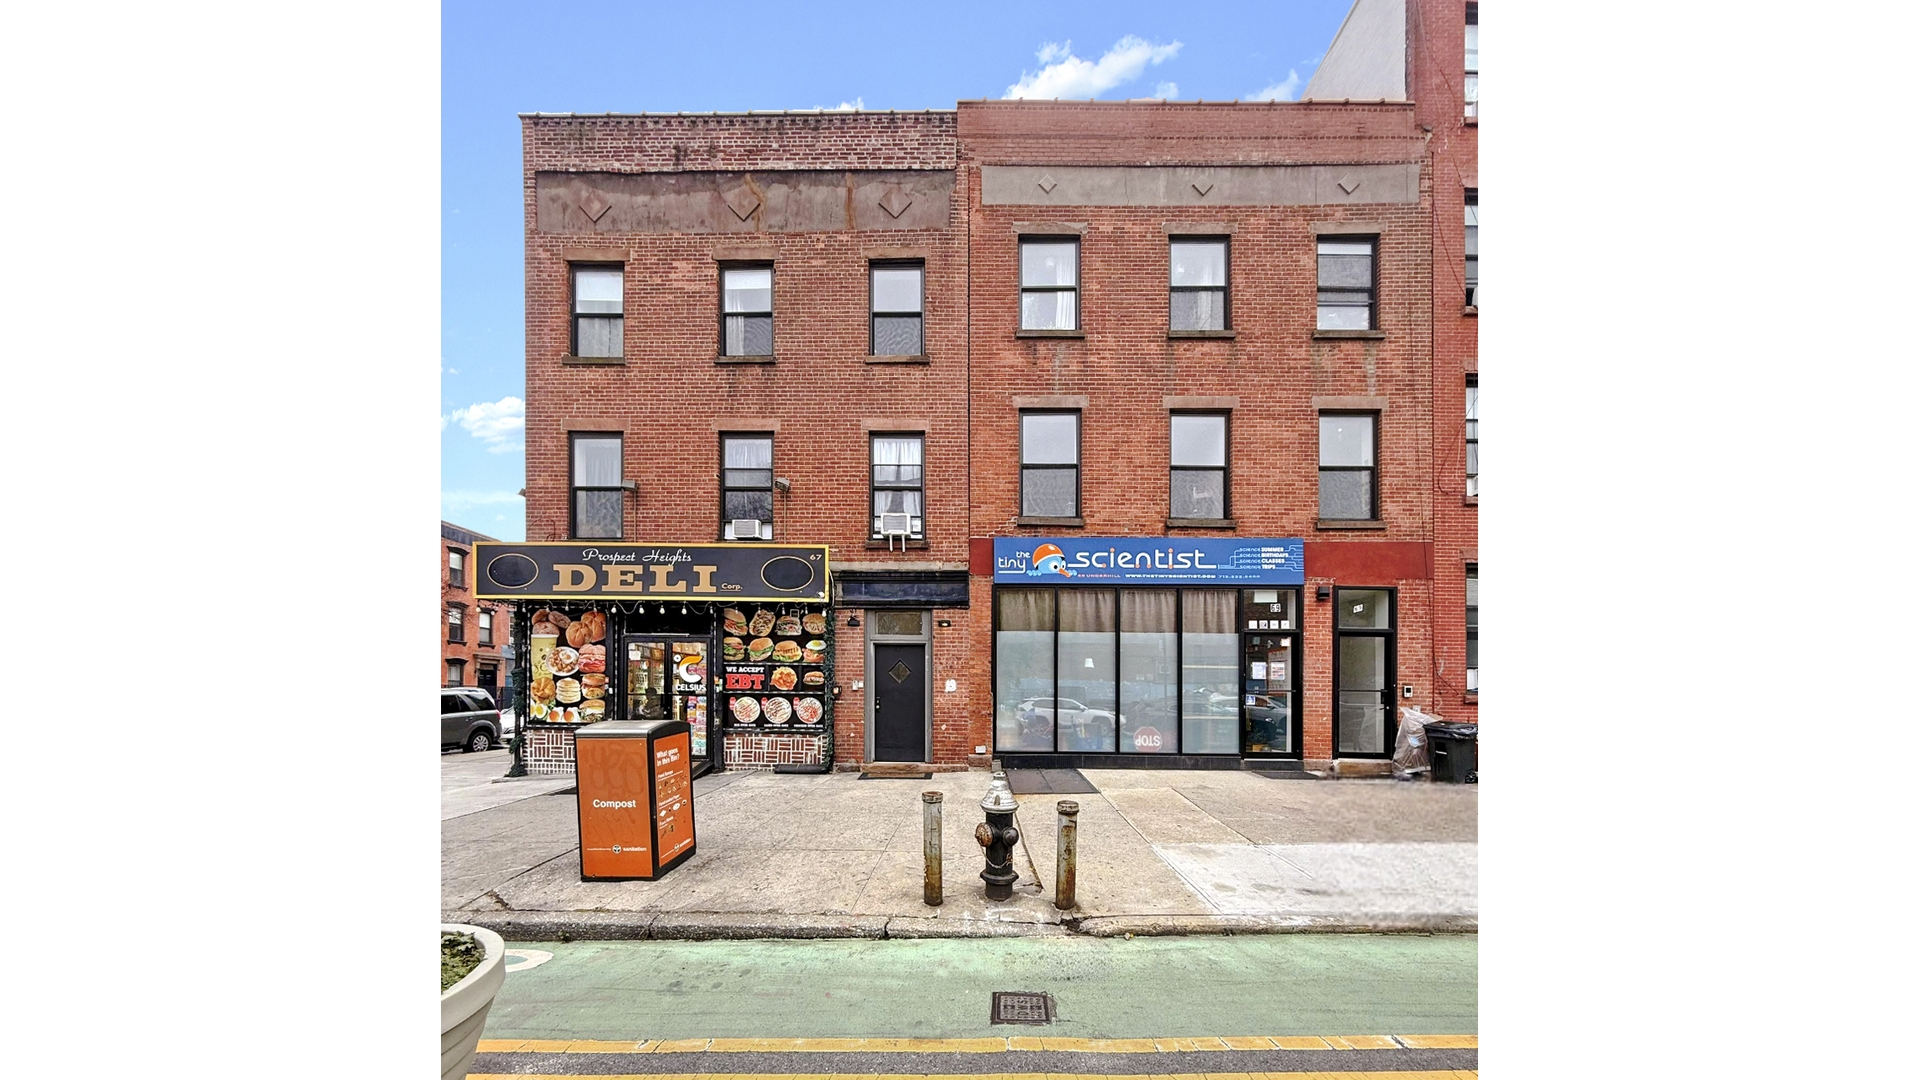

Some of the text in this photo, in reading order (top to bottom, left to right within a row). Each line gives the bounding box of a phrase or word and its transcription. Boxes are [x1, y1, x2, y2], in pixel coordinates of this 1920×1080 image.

[582, 548, 692, 566] Prospect Heights
[1067, 548, 1217, 569] scientist
[998, 557, 1026, 574] tiny
[552, 564, 718, 592] DELI
[721, 583, 743, 591] Corp.
[1270, 604, 1281, 612] 69
[726, 674, 765, 689] EBT
[1135, 735, 1161, 746] STOP
[593, 799, 636, 810] Compost
